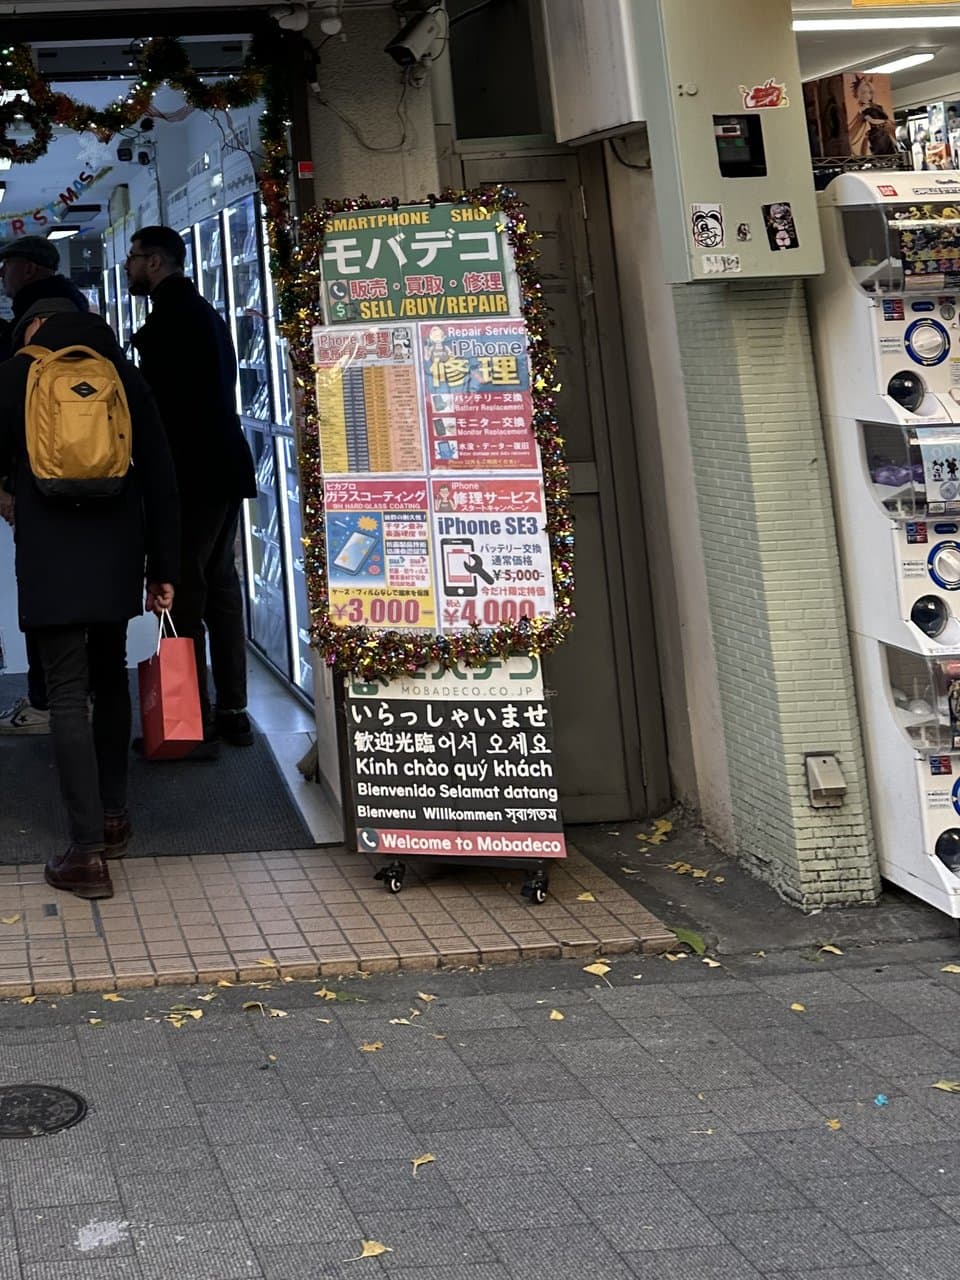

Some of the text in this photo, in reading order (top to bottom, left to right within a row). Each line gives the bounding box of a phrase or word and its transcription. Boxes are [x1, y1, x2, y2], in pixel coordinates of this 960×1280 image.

[325, 211, 430, 233] SMARTPHONE
[323, 228, 499, 275] モバデコ
[360, 301, 396, 320] SELL
[448, 325, 526, 338] Repair Service
[451, 339, 523, 356] iPhone
[430, 356, 521, 388] 修理
[457, 417, 526, 428] モニター交換
[451, 482, 479, 490] iPhone
[326, 490, 426, 503] ガラスコーティング
[452, 491, 539, 505] 修理サービス
[437, 516, 539, 536] iPhone SE3
[480, 543, 543, 554] バッテリー交換
[491, 555, 533, 567] 通常価格
[401, 686, 533, 696] MOBADECO.CO.JP
[351, 701, 549, 728] いらっしゃいませ
[438, 732, 478, 757] 어서
[486, 732, 552, 756] 오세요
[356, 757, 553, 781] Kính chào quý khách
[357, 782, 559, 802] Bienvenido Selamat datang
[357, 805, 417, 819] Bienvenu
[423, 807, 502, 821] Willkommen
[382, 834, 562, 853] Welcome to Mobadeco
